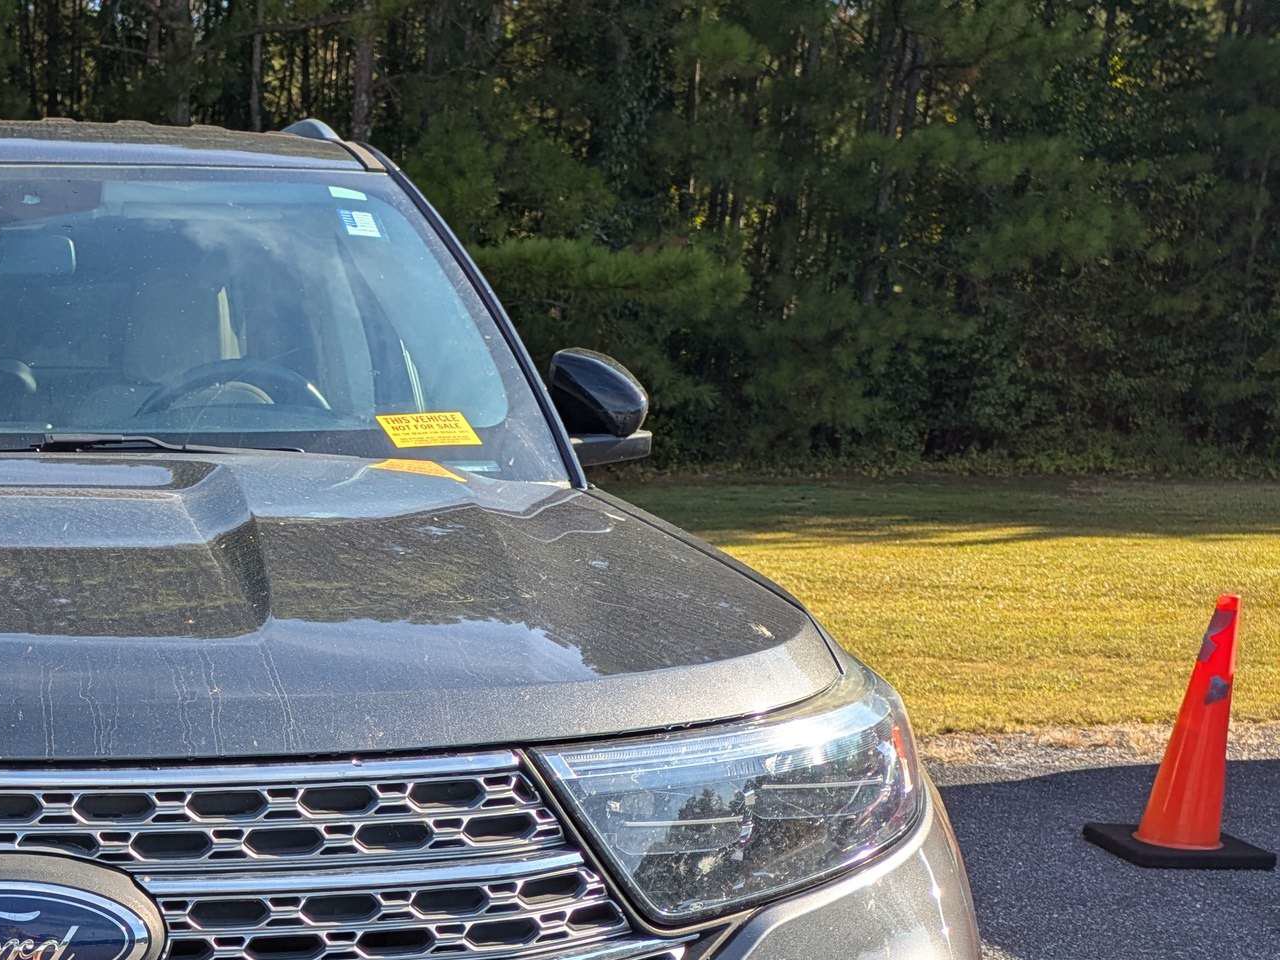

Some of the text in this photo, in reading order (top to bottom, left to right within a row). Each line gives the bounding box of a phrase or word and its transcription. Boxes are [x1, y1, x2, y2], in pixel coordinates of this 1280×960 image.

[382, 414, 460, 425] THIS VEHICLE
[391, 422, 463, 432] NOT FOR SALE
